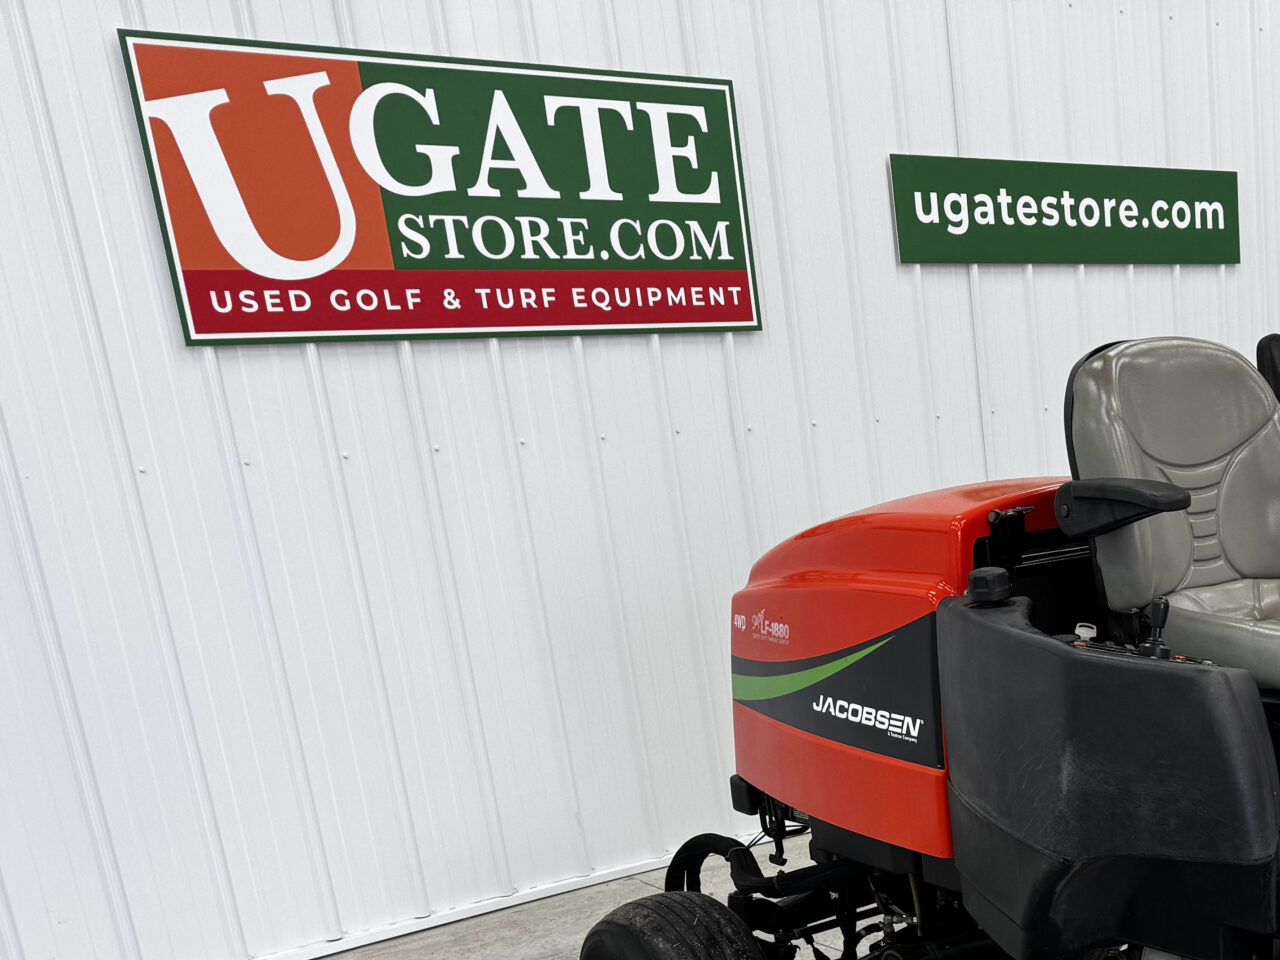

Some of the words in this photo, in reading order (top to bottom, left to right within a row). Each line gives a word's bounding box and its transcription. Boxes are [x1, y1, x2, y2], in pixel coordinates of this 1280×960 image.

[914, 188, 1225, 235] ugatestore.com
[397, 213, 734, 261] STORE.COM
[209, 289, 312, 314] USED
[329, 289, 421, 312] GOLF
[443, 288, 462, 310] &
[474, 287, 556, 309] TURF
[571, 286, 742, 312] EQUIPMENT
[734, 614, 746, 631] 4WD
[812, 695, 921, 738] JACOBSEN
